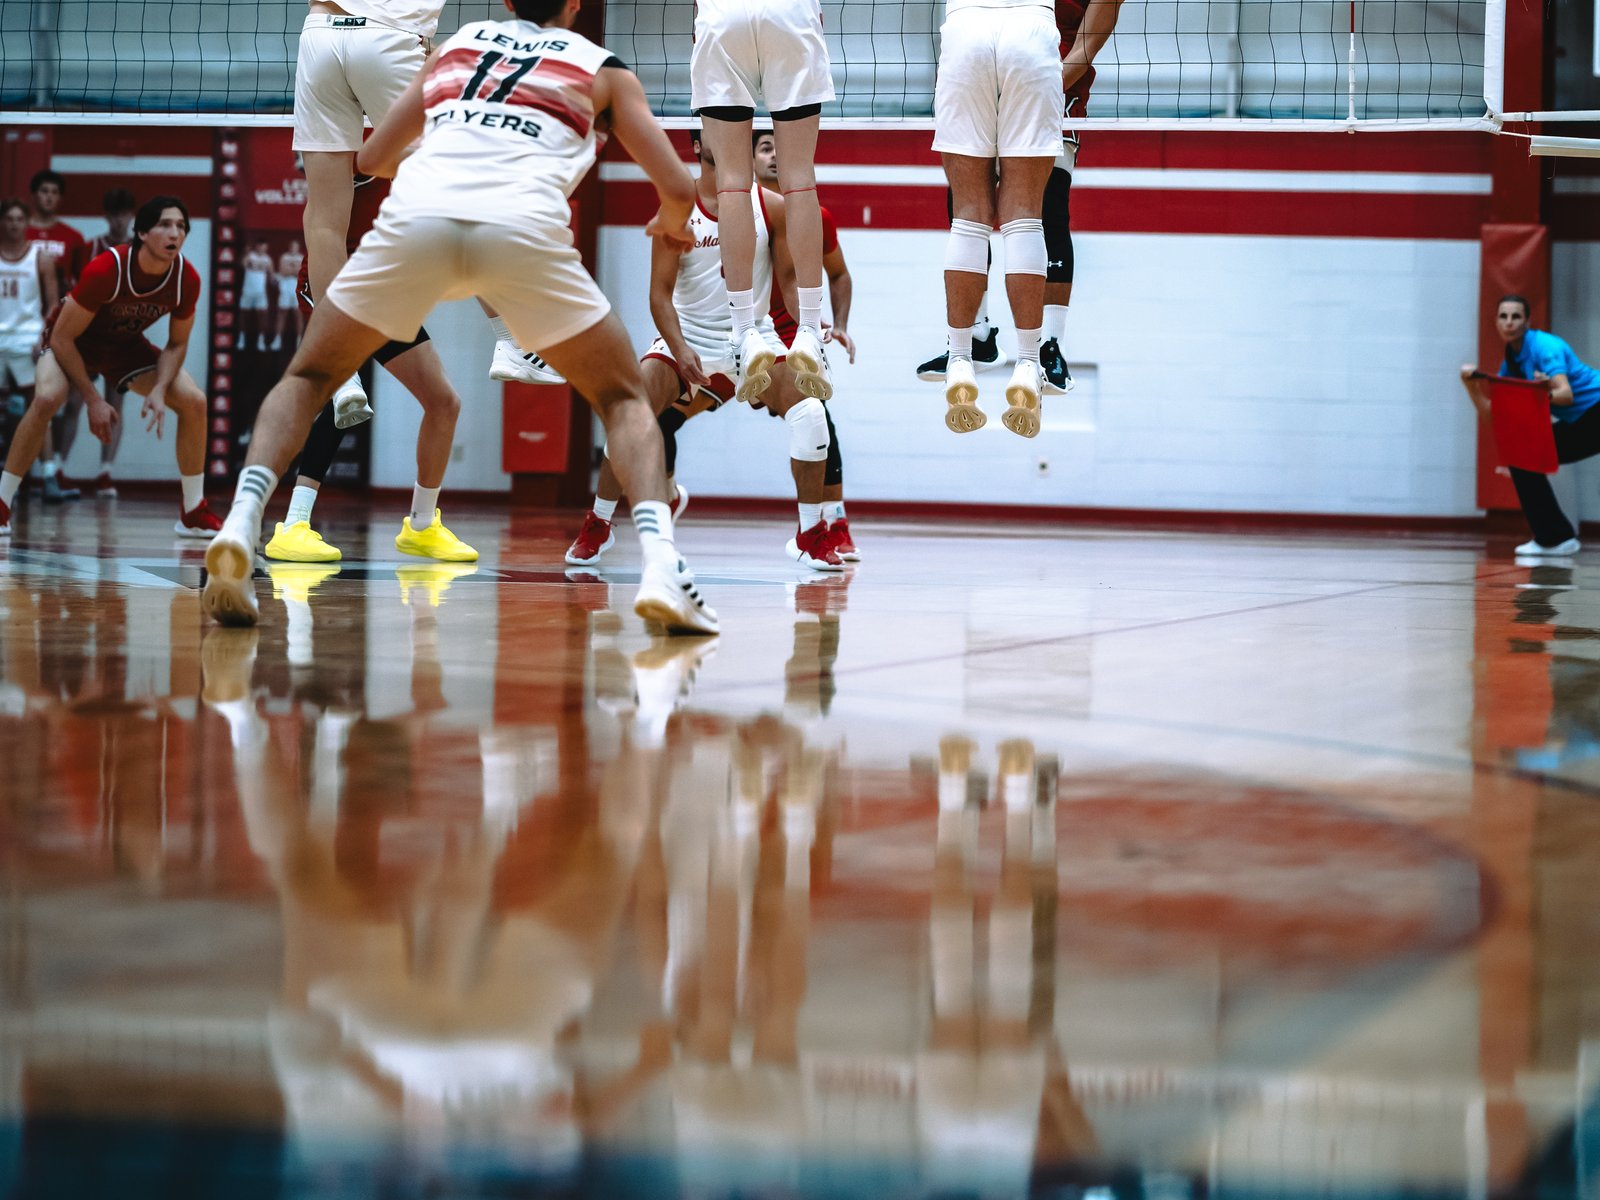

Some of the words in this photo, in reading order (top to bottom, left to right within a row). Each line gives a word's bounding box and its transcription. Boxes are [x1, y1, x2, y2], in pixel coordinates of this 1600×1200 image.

[474, 29, 570, 52] LEWIS
[460, 50, 542, 103] 17
[433, 109, 543, 138] FYERS
